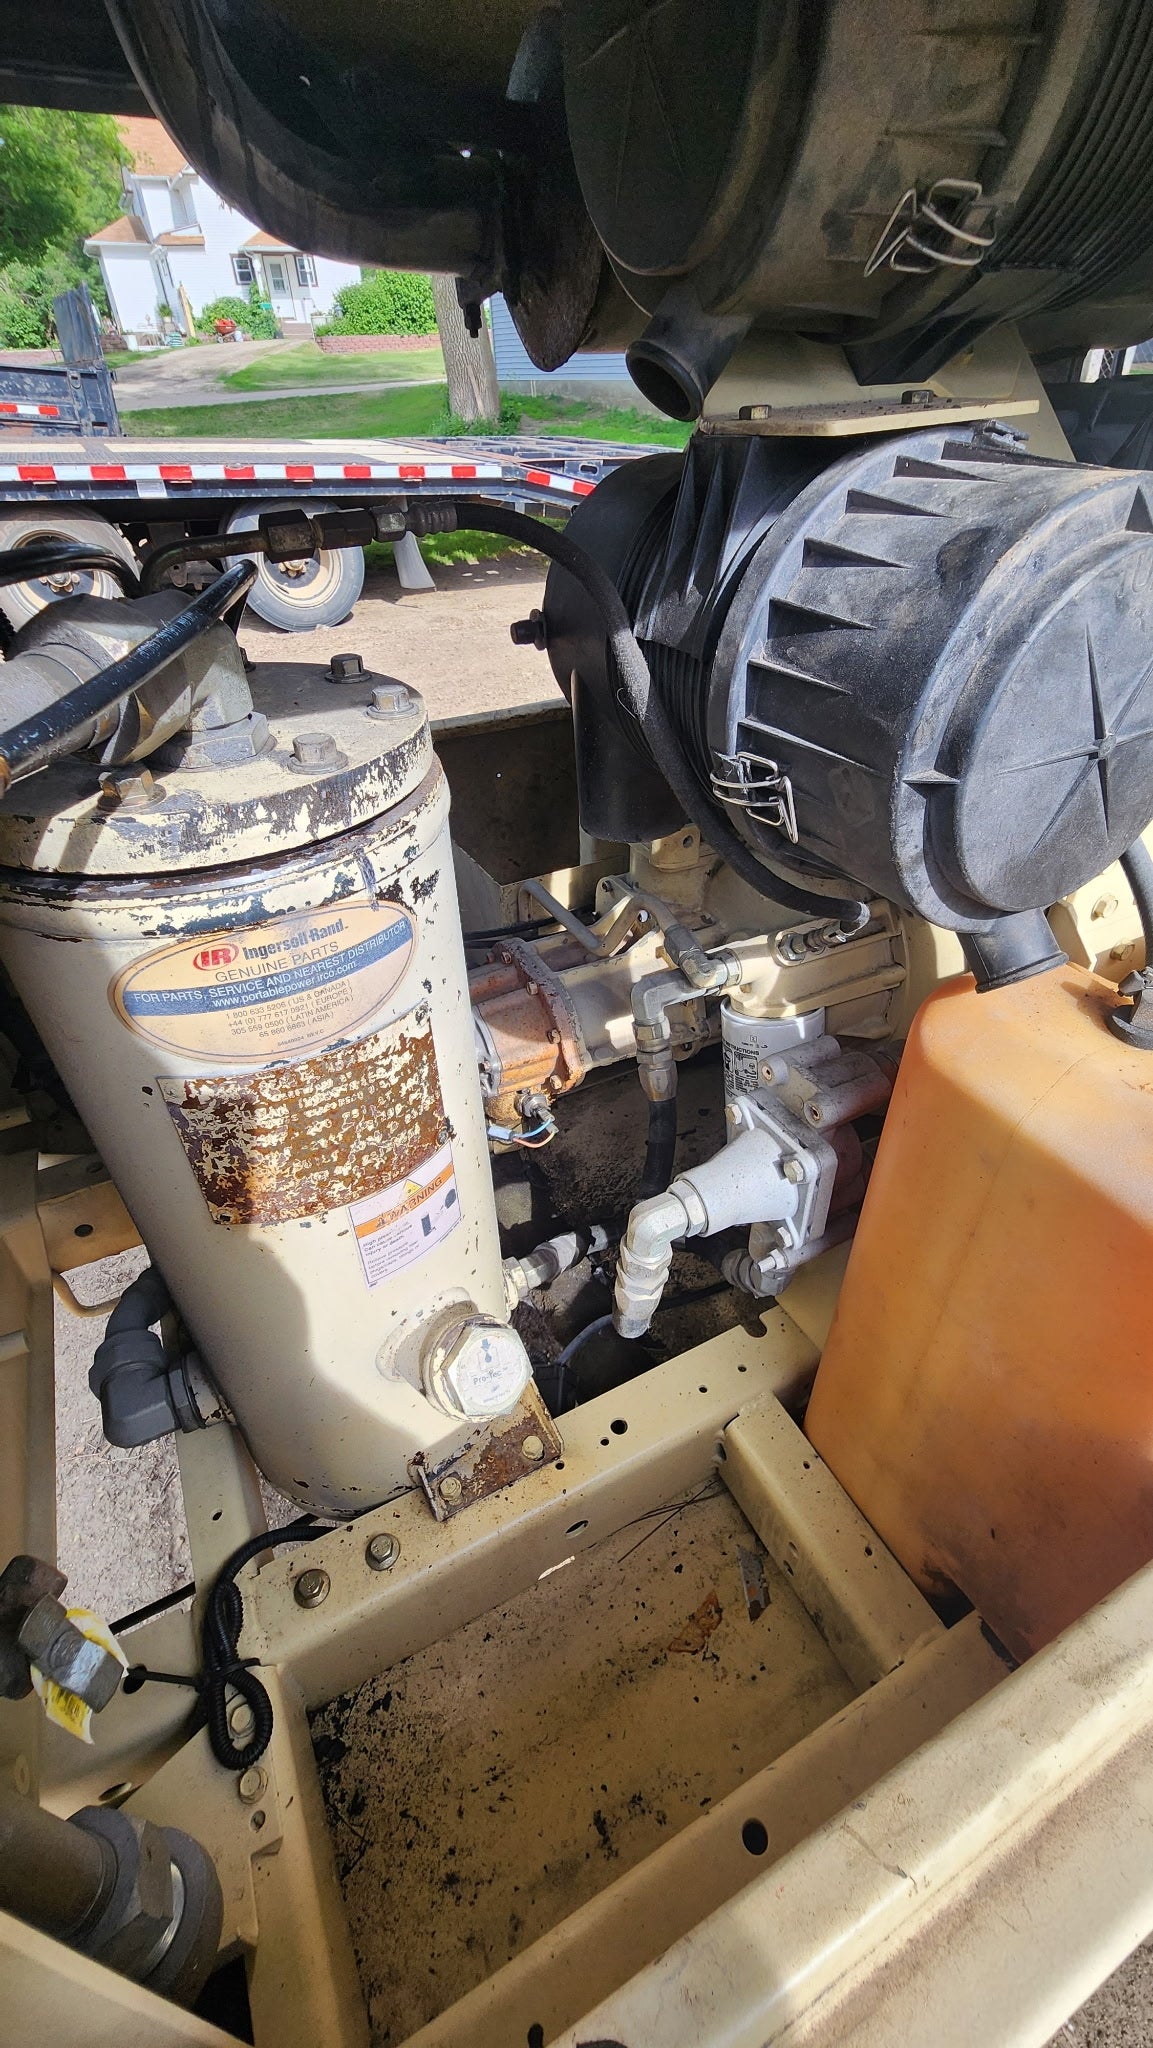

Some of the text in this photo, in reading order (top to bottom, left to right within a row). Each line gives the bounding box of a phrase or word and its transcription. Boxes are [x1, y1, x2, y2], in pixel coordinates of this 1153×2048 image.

[134, 920, 406, 1003] FOR PARTS, SERVICE AND NEAREST DISTRIBUTOR
[198, 947, 234, 968] IR
[215, 941, 339, 982] GENUINE PARTS
[387, 1176, 443, 1221] WARNING
